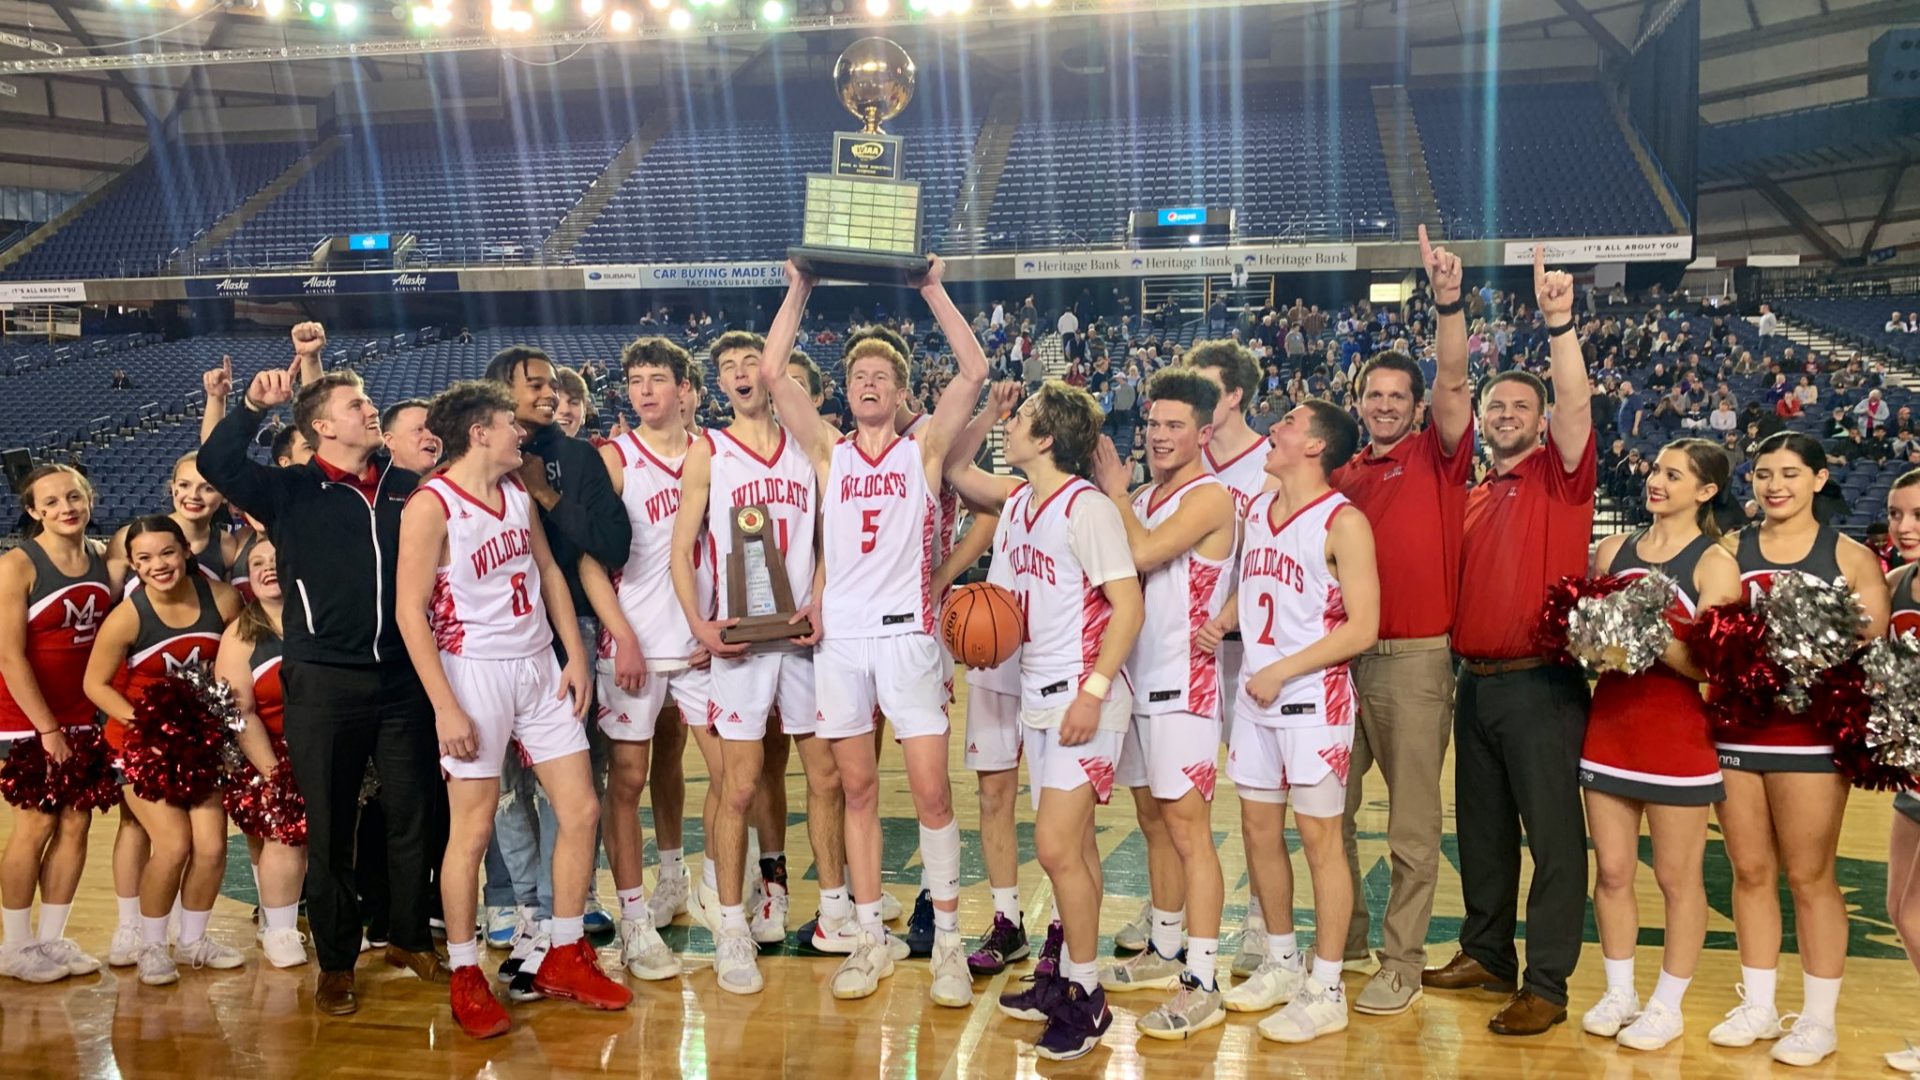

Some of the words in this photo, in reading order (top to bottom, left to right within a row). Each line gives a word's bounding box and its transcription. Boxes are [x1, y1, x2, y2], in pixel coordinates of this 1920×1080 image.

[1038, 260, 1087, 273] Heritage
[1091, 258, 1120, 270] Bank
[1146, 256, 1197, 270] Heritage
[1201, 255, 1231, 267] Bank
[1259, 254, 1312, 266] Heritage
[1316, 251, 1347, 264] Bank
[392, 273, 426, 286] Alaska
[653, 268, 677, 279] CAR
[681, 267, 727, 279] BUYING
[732, 266, 766, 278] MADE
[770, 266, 785, 277] SI
[216, 278, 249, 290] Alaska
[303, 275, 336, 288] Alaska
[840, 472, 906, 503] WILDCATS
[731, 478, 808, 513] WILDCATS
[645, 488, 682, 525] WILD
[861, 509, 882, 554] 5
[1242, 547, 1304, 594] WILDCATS
[1257, 592, 1275, 646] 2
